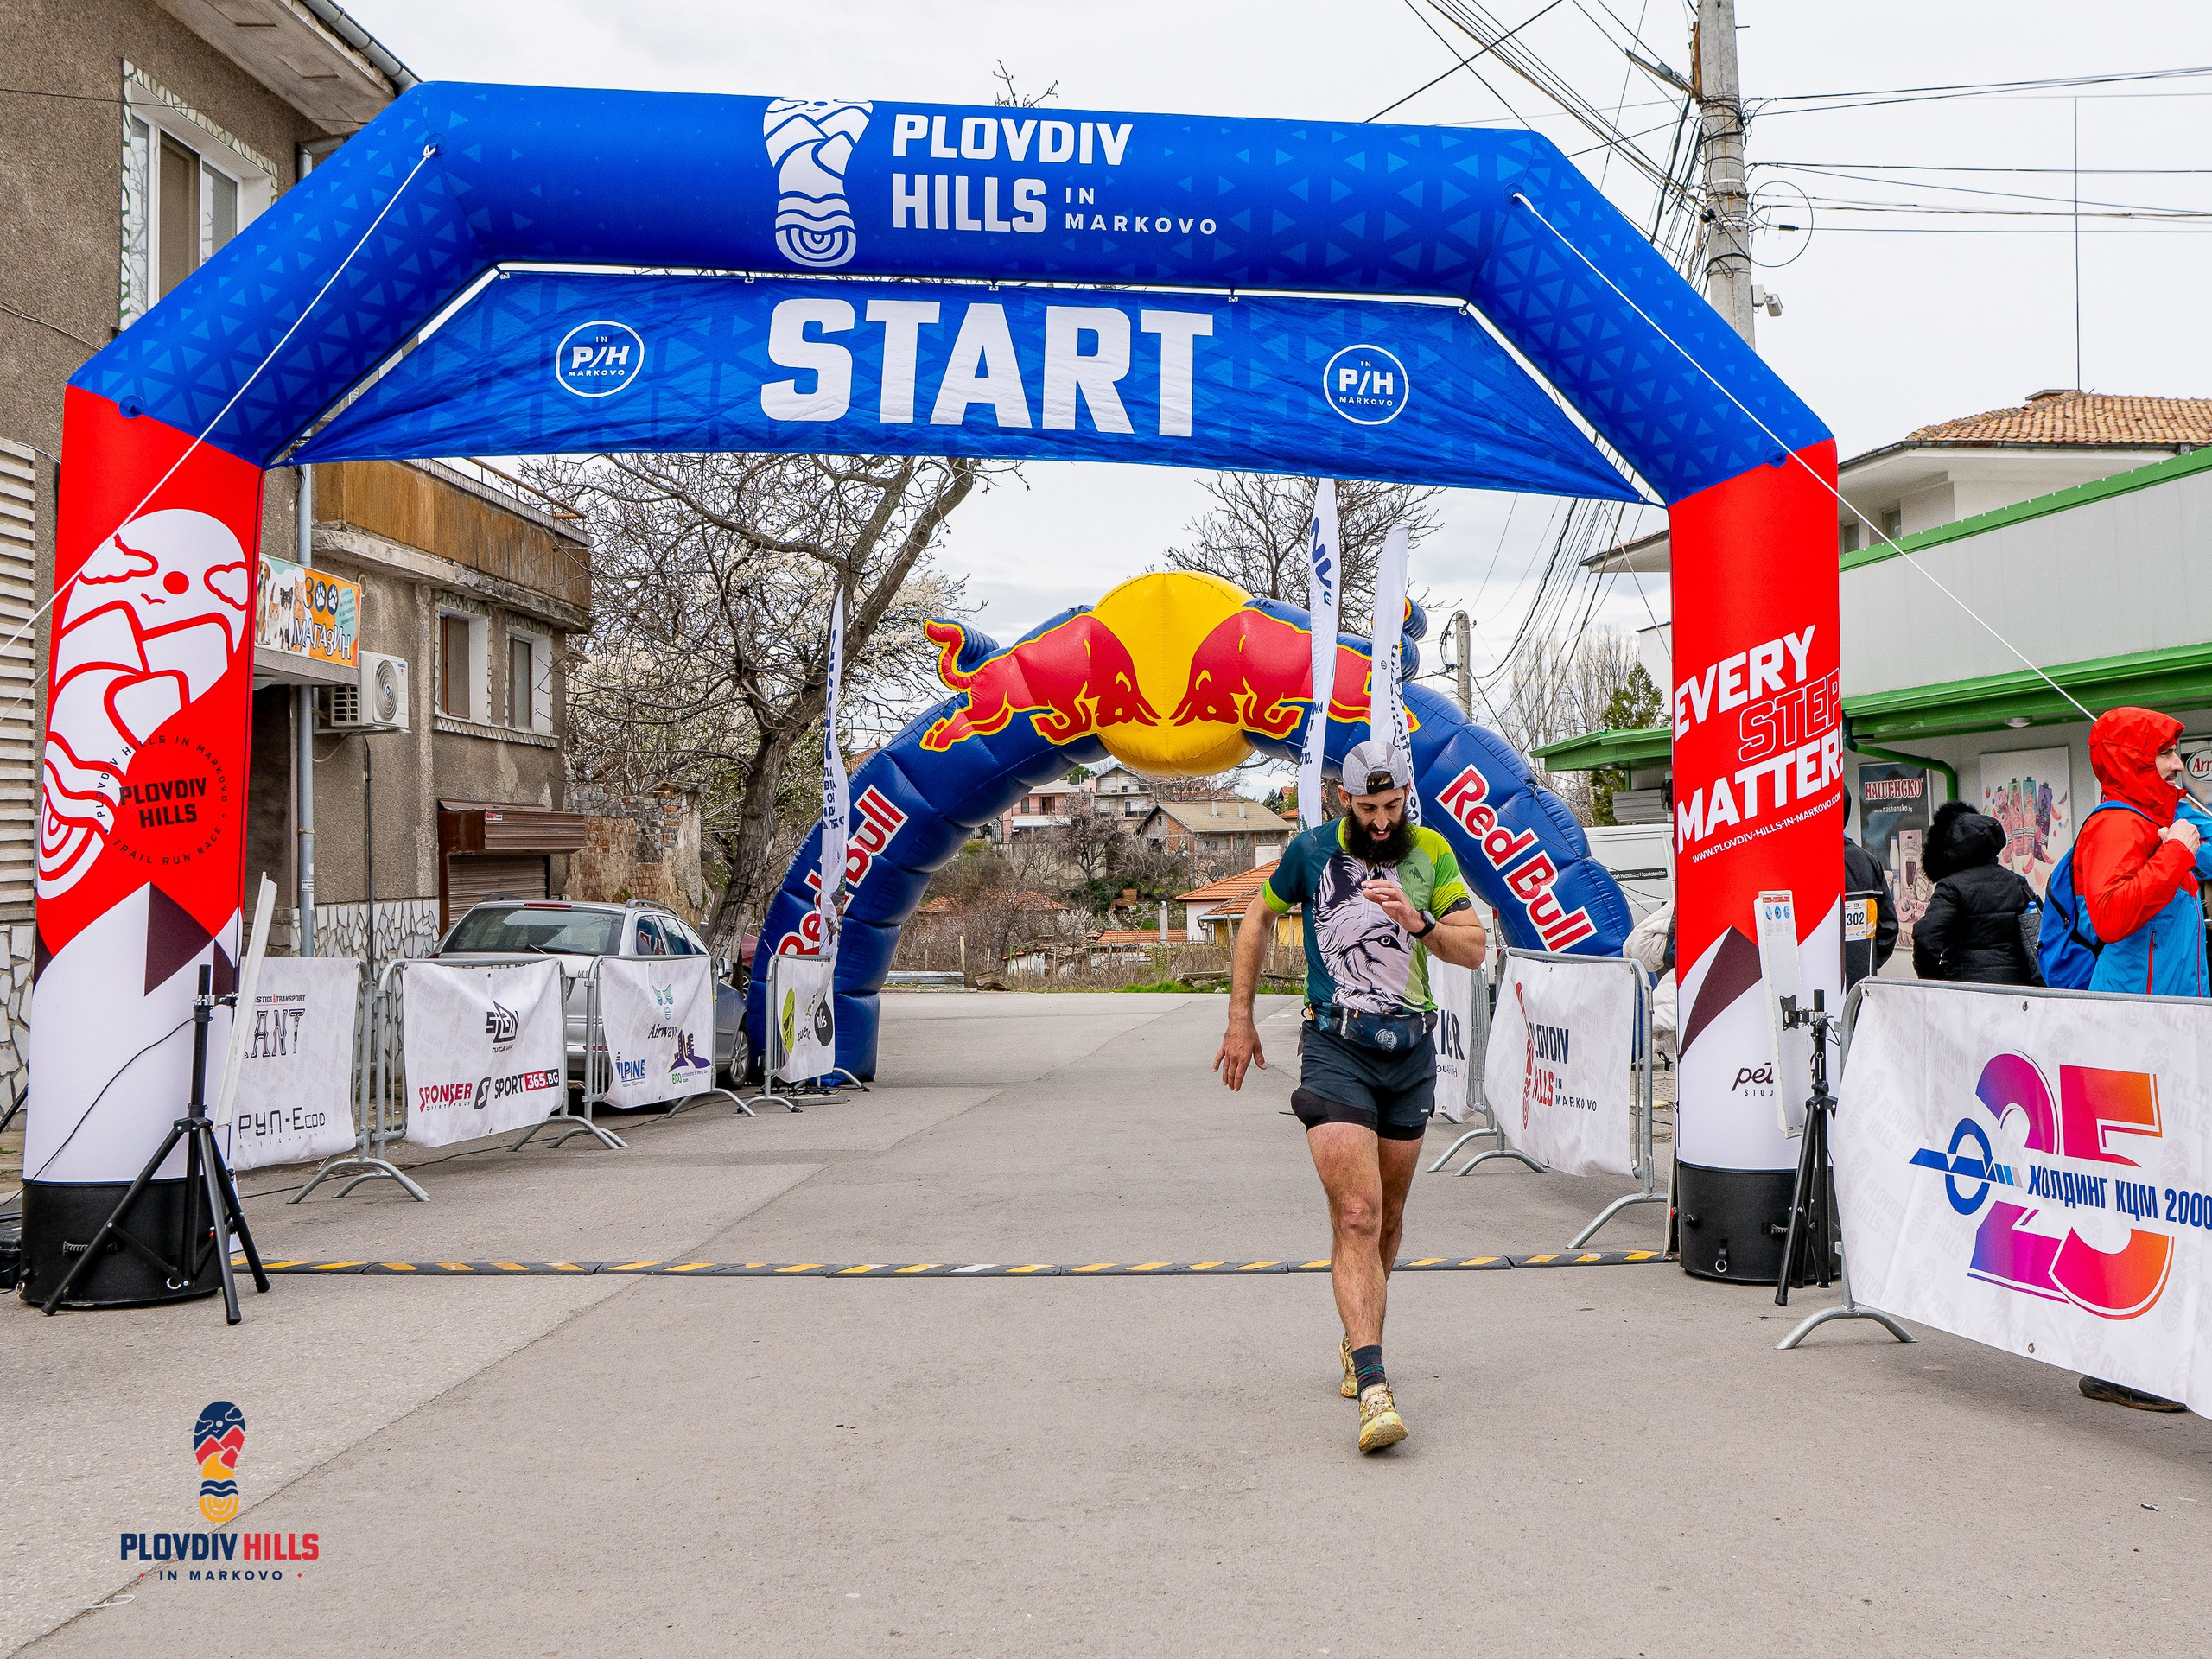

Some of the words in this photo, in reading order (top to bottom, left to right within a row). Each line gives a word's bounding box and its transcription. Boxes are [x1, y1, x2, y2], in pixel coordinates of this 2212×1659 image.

[893, 113, 1133, 166] PLOVDIV
[892, 173, 1046, 233] HILLS
[1065, 188, 1095, 205] IN
[1065, 213, 1217, 235] MARKOVO
[571, 346, 630, 369] P/H
[760, 298, 1213, 437] START
[1339, 368, 1394, 396] P/H
[1338, 396, 1393, 407] MARKOVO
[293, 617, 352, 659] МАГАЗИН
[1675, 624, 1815, 741] EVERY
[1738, 667, 1840, 762] STEP
[96, 758, 118, 817] PLOVDIV
[122, 735, 166, 757] HILLS
[175, 736, 190, 746] IN
[196, 744, 227, 802] MARKOVO
[2191, 757, 2212, 772] Arr
[119, 778, 207, 806] PLOVDIV
[1864, 778, 1923, 801] НАШЕНСКО
[139, 804, 197, 828] HILLS
[1692, 791, 1841, 863] WWW.PLOVDIV-HILLS-IN-MARKOVO.COM
[113, 839, 152, 864] TRAIL
[162, 854, 191, 865] RUN
[197, 827, 221, 855] RACE
[1438, 766, 1536, 868] Red
[1504, 853, 1595, 952] Bull
[1847, 912, 1865, 926] 302
[276, 995, 306, 1003] TRANSPORT
[244, 1009, 306, 1059] ANT
[419, 1083, 473, 1113] SPONSER
[1555, 1077, 1562, 1090] IN
[1555, 1094, 1598, 1112] MARKOVO
[2027, 1164, 2108, 1210] ХОЛДИНГ
[2115, 1179, 2158, 1222] КЦМ
[2164, 1188, 2212, 1230] 2000
